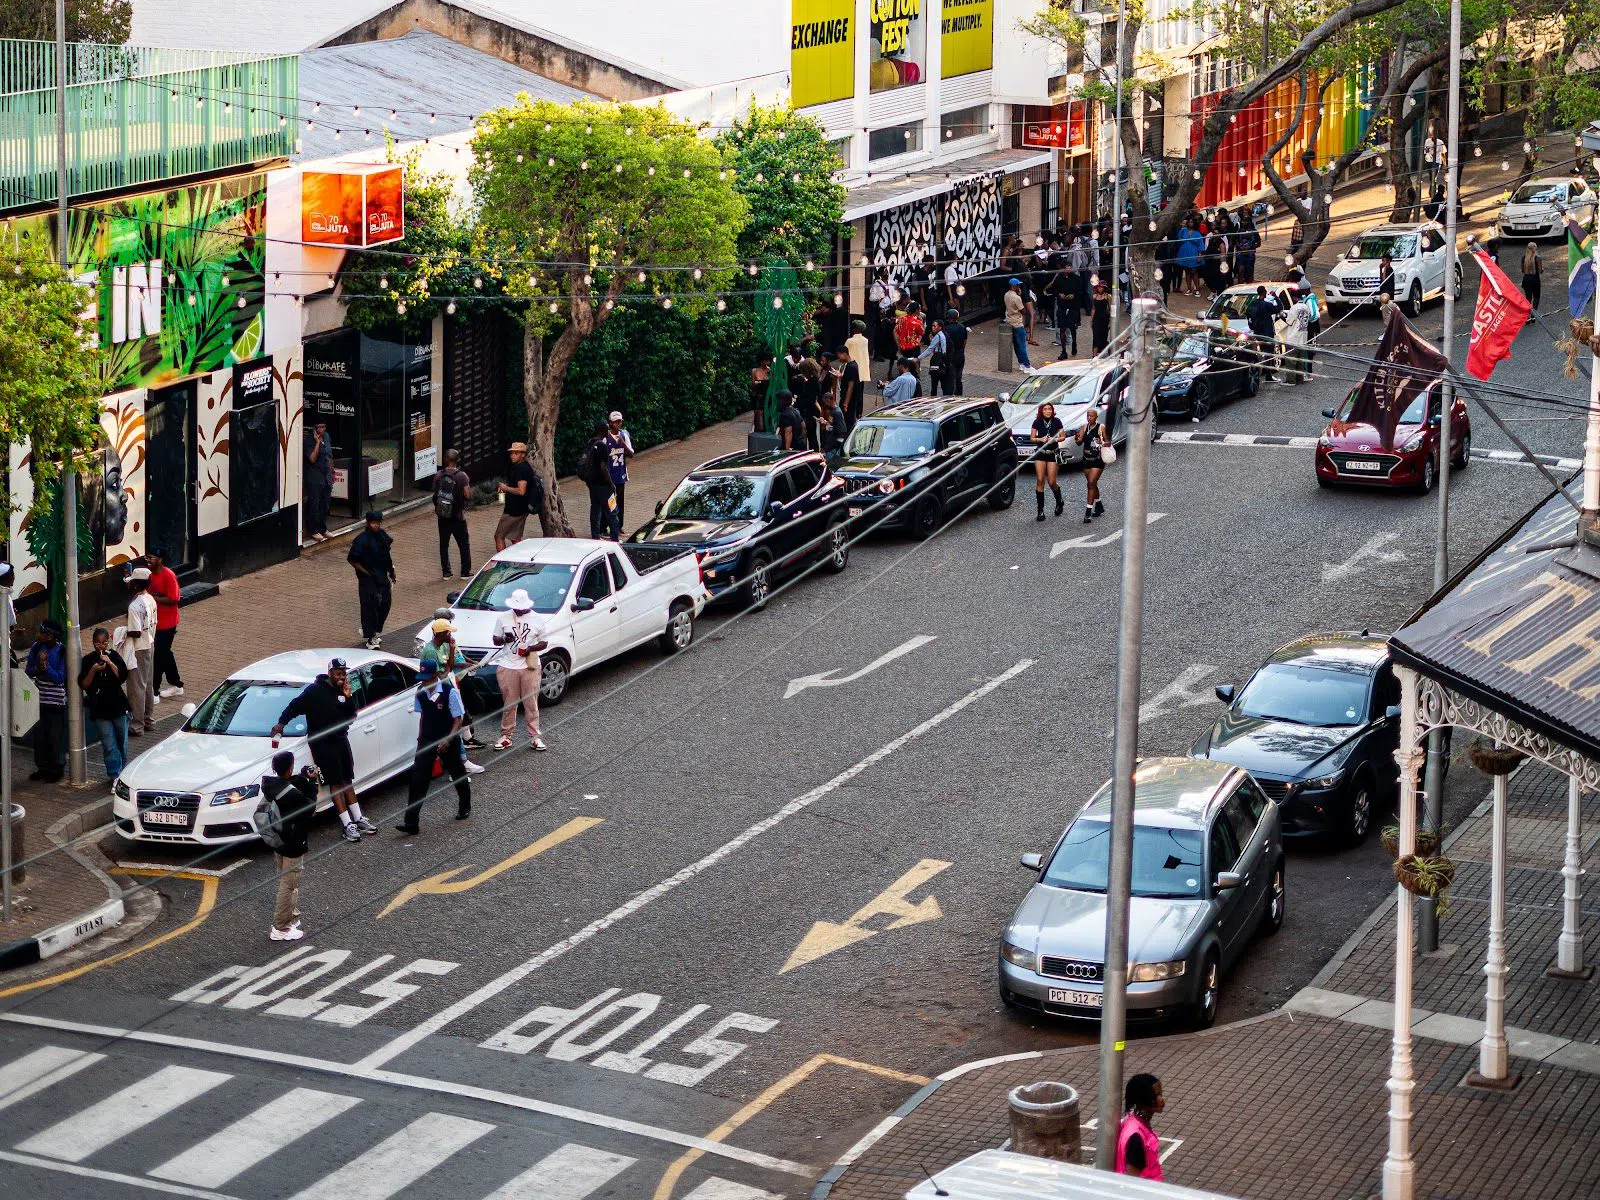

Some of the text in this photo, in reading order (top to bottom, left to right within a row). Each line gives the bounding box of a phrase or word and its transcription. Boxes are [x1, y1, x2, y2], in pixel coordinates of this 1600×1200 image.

[791, 17, 849, 50] EXCHANGE
[941, 13, 983, 35] WE MULTIPLY.
[880, 18, 909, 57] FEST
[1041, 133, 1058, 141] JUTA
[327, 215, 349, 234] 70 JUTA
[380, 212, 395, 231] 70 JUTA
[112, 259, 162, 344] IN
[1470, 295, 1505, 344] CASTL
[1490, 310, 1507, 333] LAGER
[612, 454, 625, 467] 24
[155, 813, 163, 823] 32
[178, 814, 187, 824] GP
[74, 915, 104, 936] JUTA ST
[168, 946, 461, 1028] STOP
[1051, 990, 1067, 1002] PCT
[1072, 992, 1089, 1005] 512
[477, 987, 780, 1087] STOP
